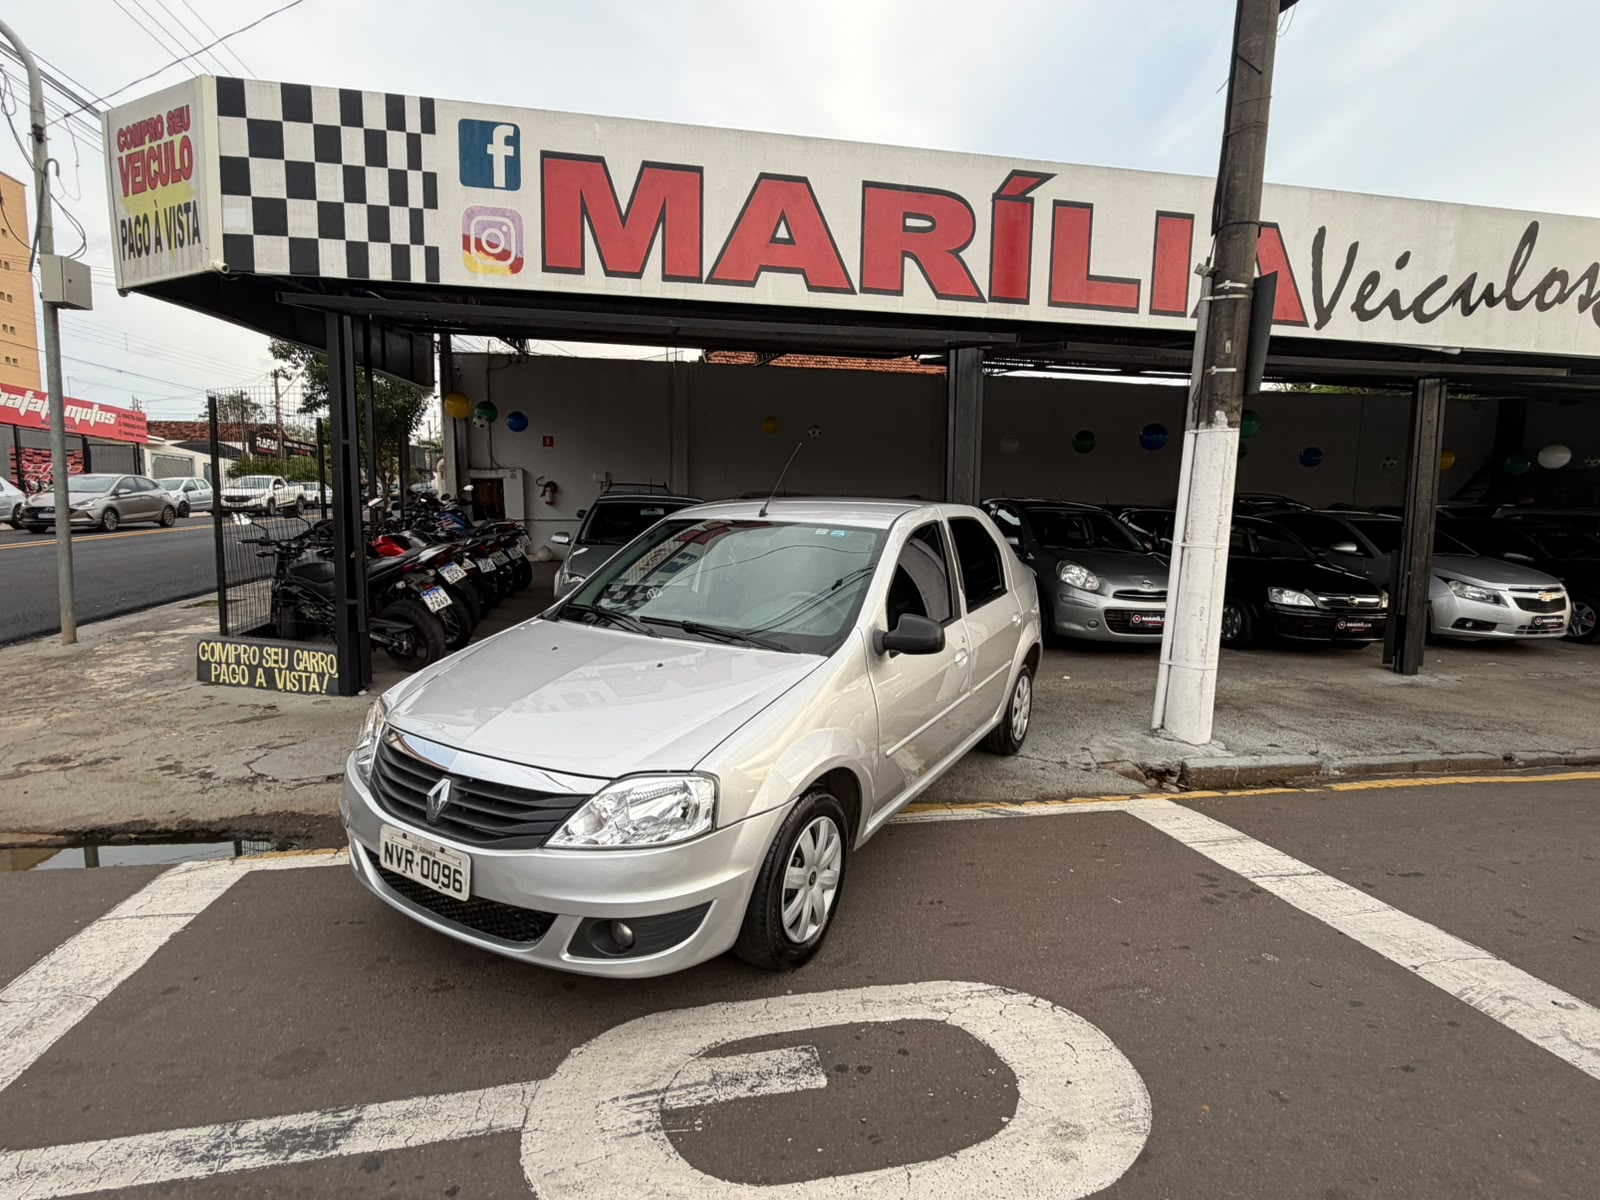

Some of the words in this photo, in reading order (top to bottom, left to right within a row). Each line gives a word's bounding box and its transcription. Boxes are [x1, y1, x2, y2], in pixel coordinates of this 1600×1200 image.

[117, 114, 164, 152] COMPRO
[166, 104, 191, 136] SEU
[120, 213, 151, 261] PAGO
[154, 199, 163, 254] À
[164, 200, 201, 250] VISTA
[199, 641, 259, 665] COMPRO
[262, 646, 289, 669] SEU
[211, 663, 249, 686] PAGO
[255, 668, 267, 688] A
[274, 668, 329, 694] VISTA!
